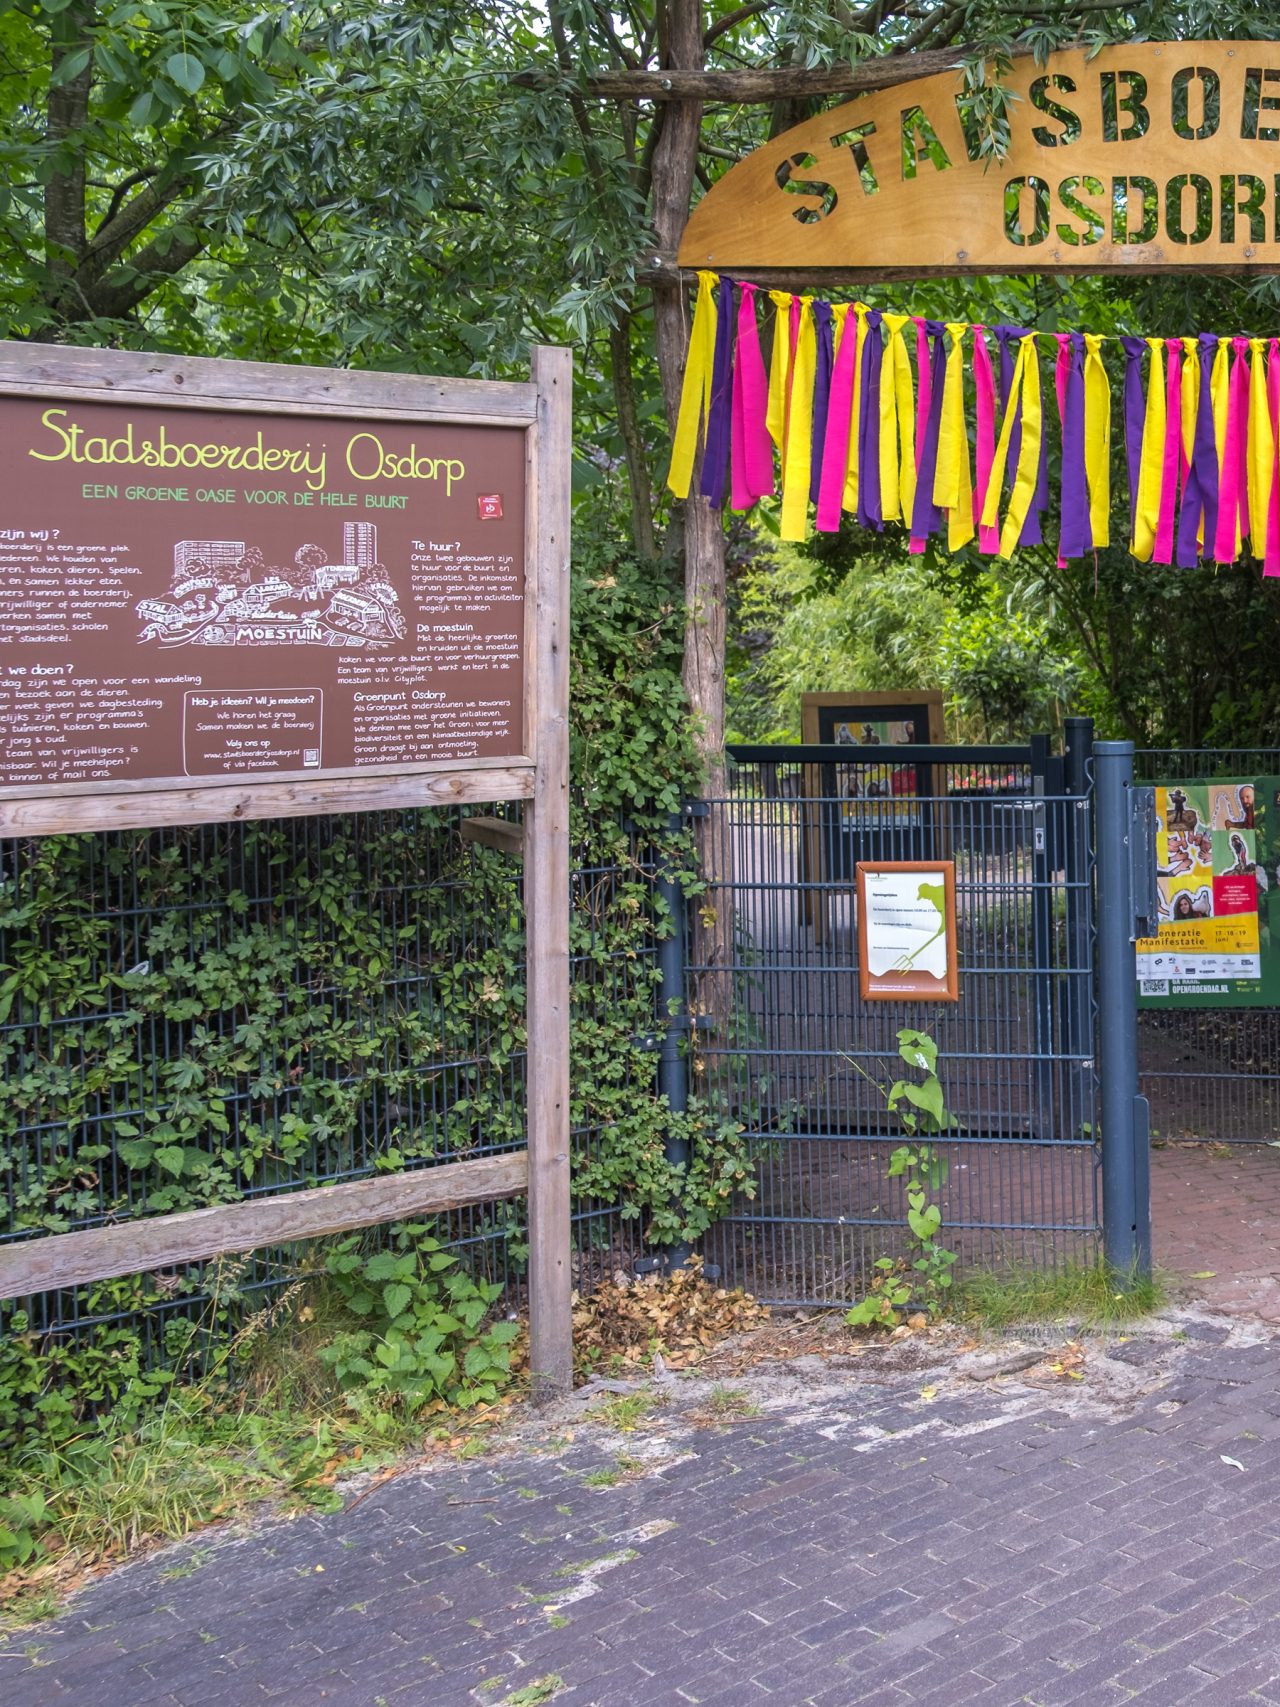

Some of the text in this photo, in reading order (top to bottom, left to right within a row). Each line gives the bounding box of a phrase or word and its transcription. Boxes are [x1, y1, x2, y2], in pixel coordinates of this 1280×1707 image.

[29, 408, 465, 496] Stadsboerderij Osdorp
[82, 484, 408, 509] EEN GROENE OASE VOOR DE HELE BUURT
[411, 541, 425, 550] Te
[141, 602, 167, 613] STAL
[417, 624, 473, 632] De moestuin
[235, 629, 321, 640] MOESTUIN
[9, 666, 27, 675] we
[72, 678, 97, 687] open
[155, 675, 201, 685] wandeling
[354, 691, 446, 702] Groenpunt Osdorp
[1172, 985, 1229, 993] OPENGROENDAG.NL
